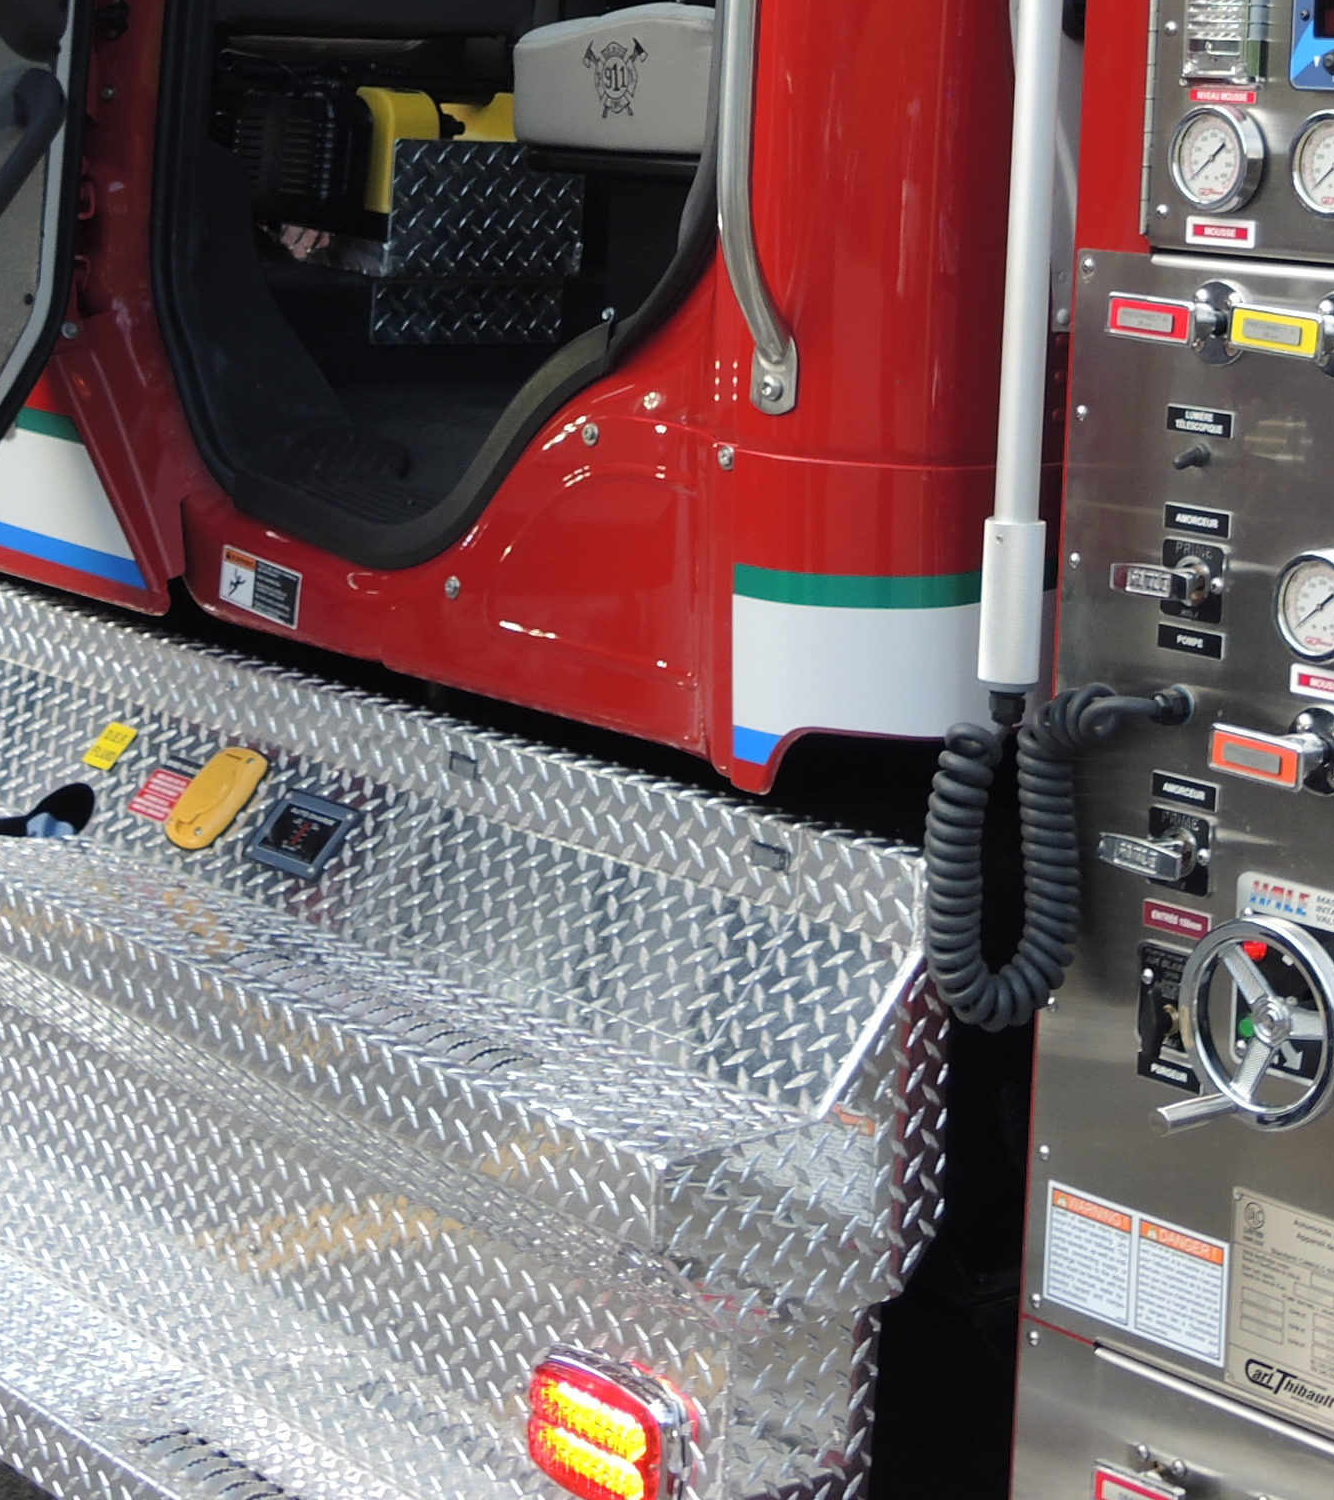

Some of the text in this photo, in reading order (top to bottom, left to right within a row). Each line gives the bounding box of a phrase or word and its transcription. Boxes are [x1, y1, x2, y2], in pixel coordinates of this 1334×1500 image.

[604, 63, 627, 92] 911
[1204, 228, 1236, 238] MOUSSE
[1249, 880, 1311, 917] HALE
[1067, 1199, 1120, 1228] WARNING
[1245, 1357, 1275, 1390] Carl
